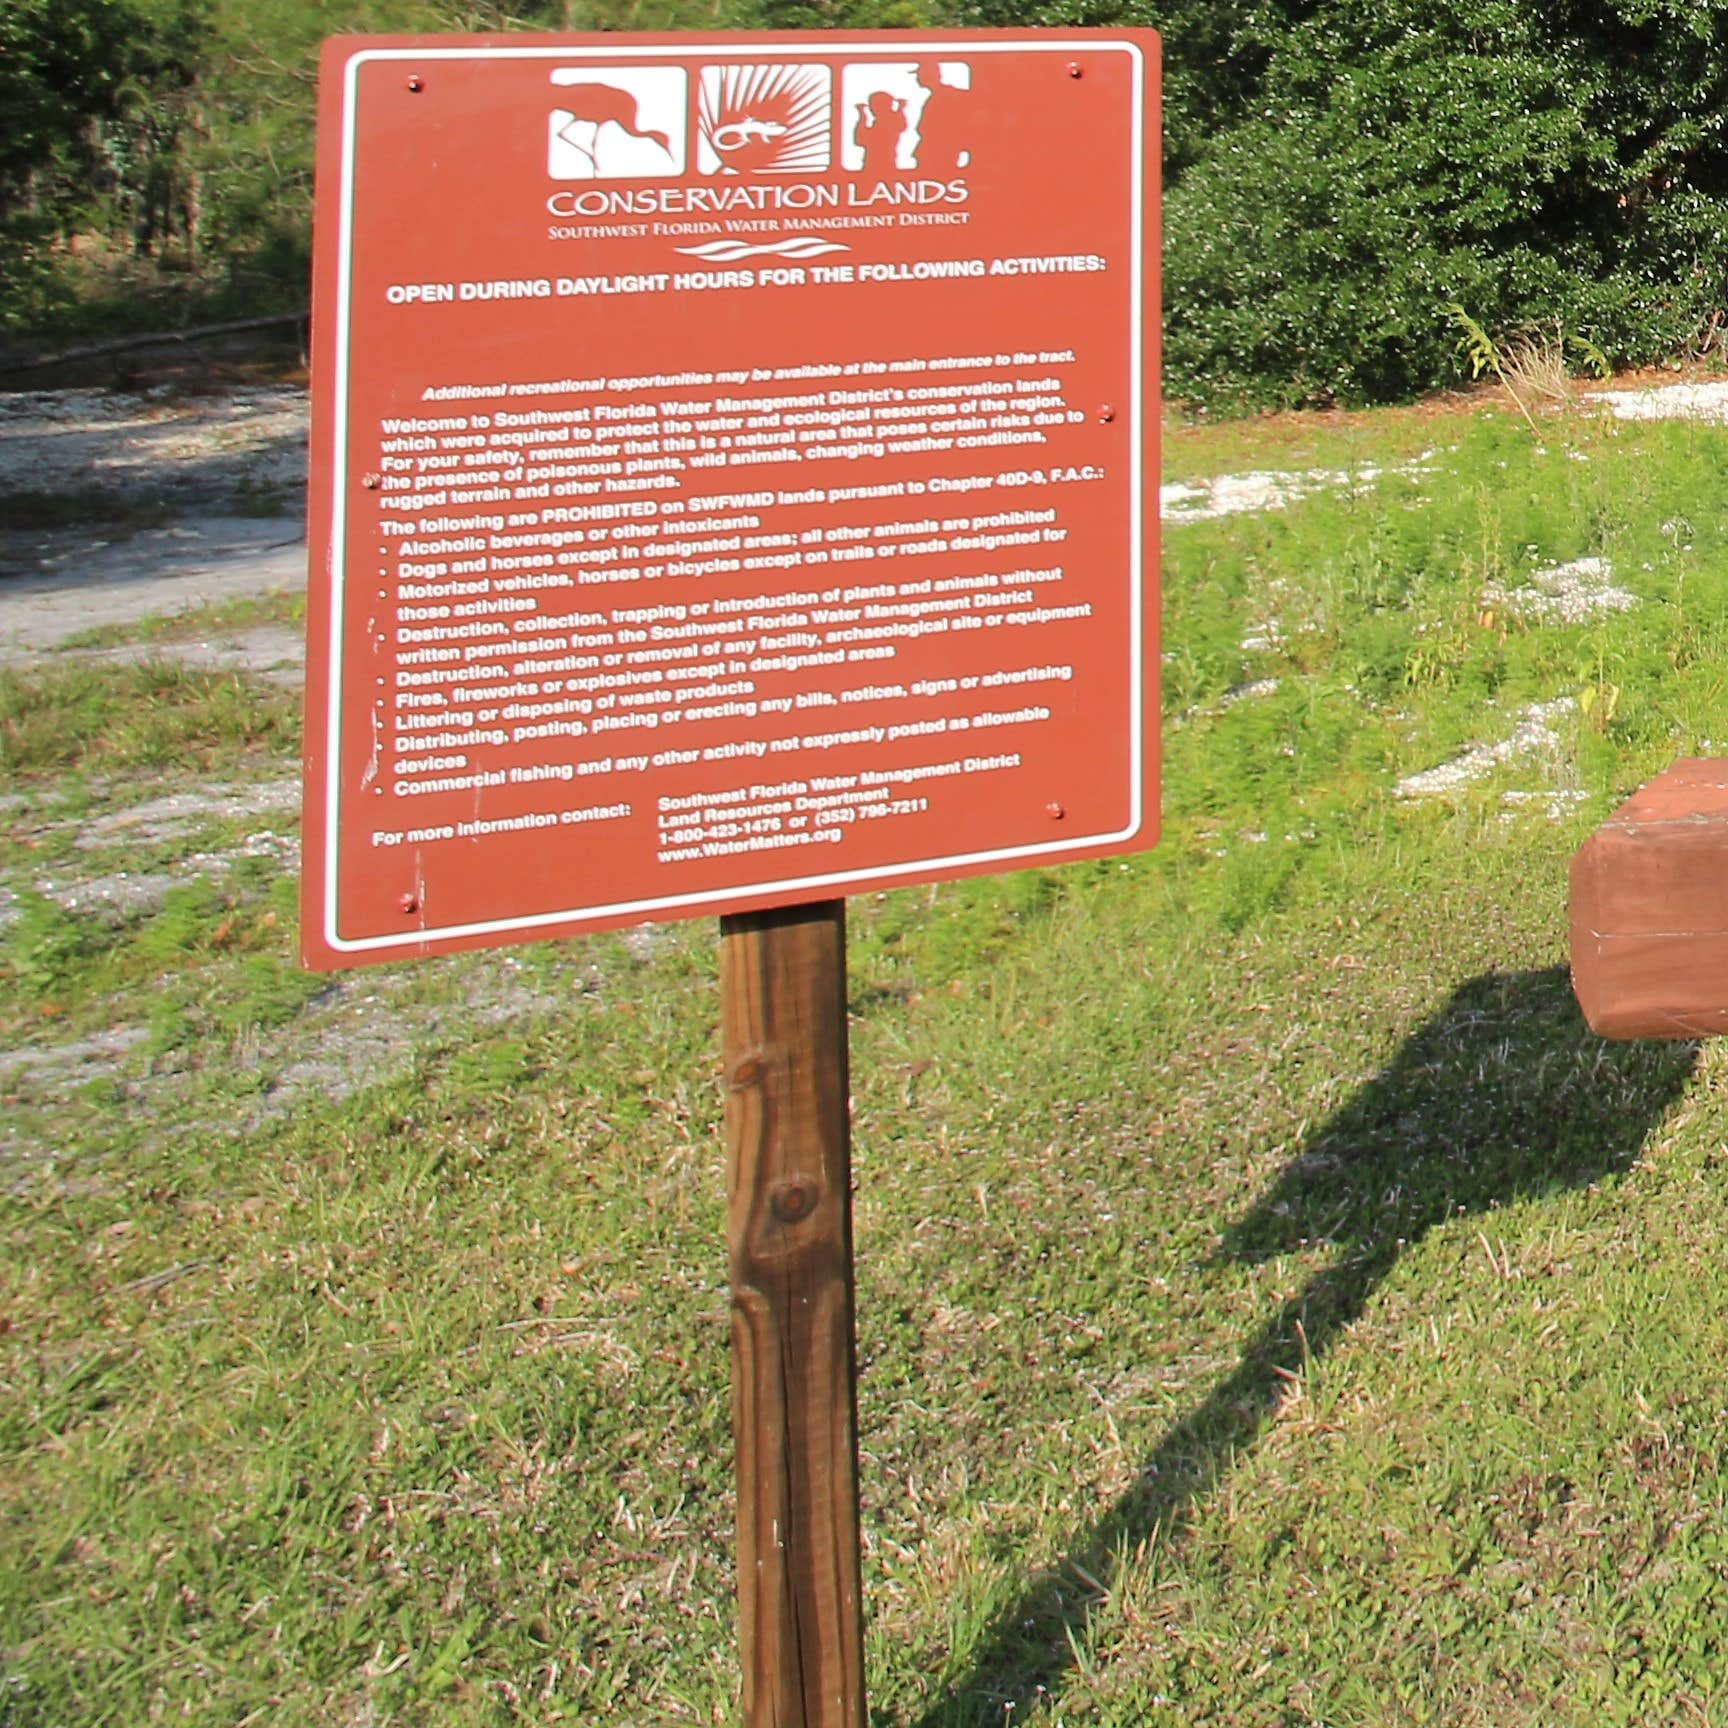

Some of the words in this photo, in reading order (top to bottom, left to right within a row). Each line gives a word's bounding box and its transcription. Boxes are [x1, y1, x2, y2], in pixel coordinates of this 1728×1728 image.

[545, 183, 839, 217] CONSERVATION
[846, 178, 969, 207] LANDS
[548, 223, 648, 240] SOUTHWEST
[652, 221, 722, 236] FLORIDA
[724, 218, 780, 232] WATER
[783, 214, 894, 230] MANAGEMENT
[898, 211, 970, 226] DISTRICT
[385, 282, 454, 305] OPEN
[458, 278, 552, 301] DURING
[555, 272, 671, 296] DAYLIGHT
[672, 268, 755, 291] HOURS
[757, 266, 806, 287] FOR
[808, 264, 855, 284] THE
[857, 258, 986, 282] FOLLOWING
[988, 253, 1106, 276] ACTIVITIES:
[380, 416, 469, 435] Welcome
[469, 414, 491, 429] to
[493, 407, 591, 428] Southwest
[592, 402, 657, 421] Florida
[658, 400, 713, 417] Water
[714, 391, 826, 414] Management
[905, 380, 1014, 401] conservation
[1014, 376, 1062, 393] lands
[397, 535, 487, 557] Alcoholic
[488, 529, 585, 550] beverages
[586, 527, 609, 542] or
[610, 522, 660, 540] other
[661, 514, 760, 536] intoxicants
[394, 709, 475, 731] Littering
[475, 707, 500, 723] or
[500, 697, 593, 720] disposing
[594, 692, 616, 710] of
[617, 688, 673, 707] waste
[673, 679, 755, 704] products
[657, 787, 747, 812] Southwest
[748, 780, 808, 800] Florida
[809, 775, 858, 792] Water
[859, 760, 962, 786] Management
[962, 752, 1021, 773] District
[371, 830, 405, 847] For
[405, 824, 455, 843] more
[455, 812, 558, 837] information
[559, 802, 631, 824] contact:
[657, 809, 702, 829] Land
[702, 800, 793, 823] Resources
[794, 786, 890, 811] Department
[658, 816, 782, 846] 1-800-423-1476
[787, 814, 808, 829] or
[813, 806, 856, 827] (352)
[656, 827, 842, 863] www.WaterMatters.org
